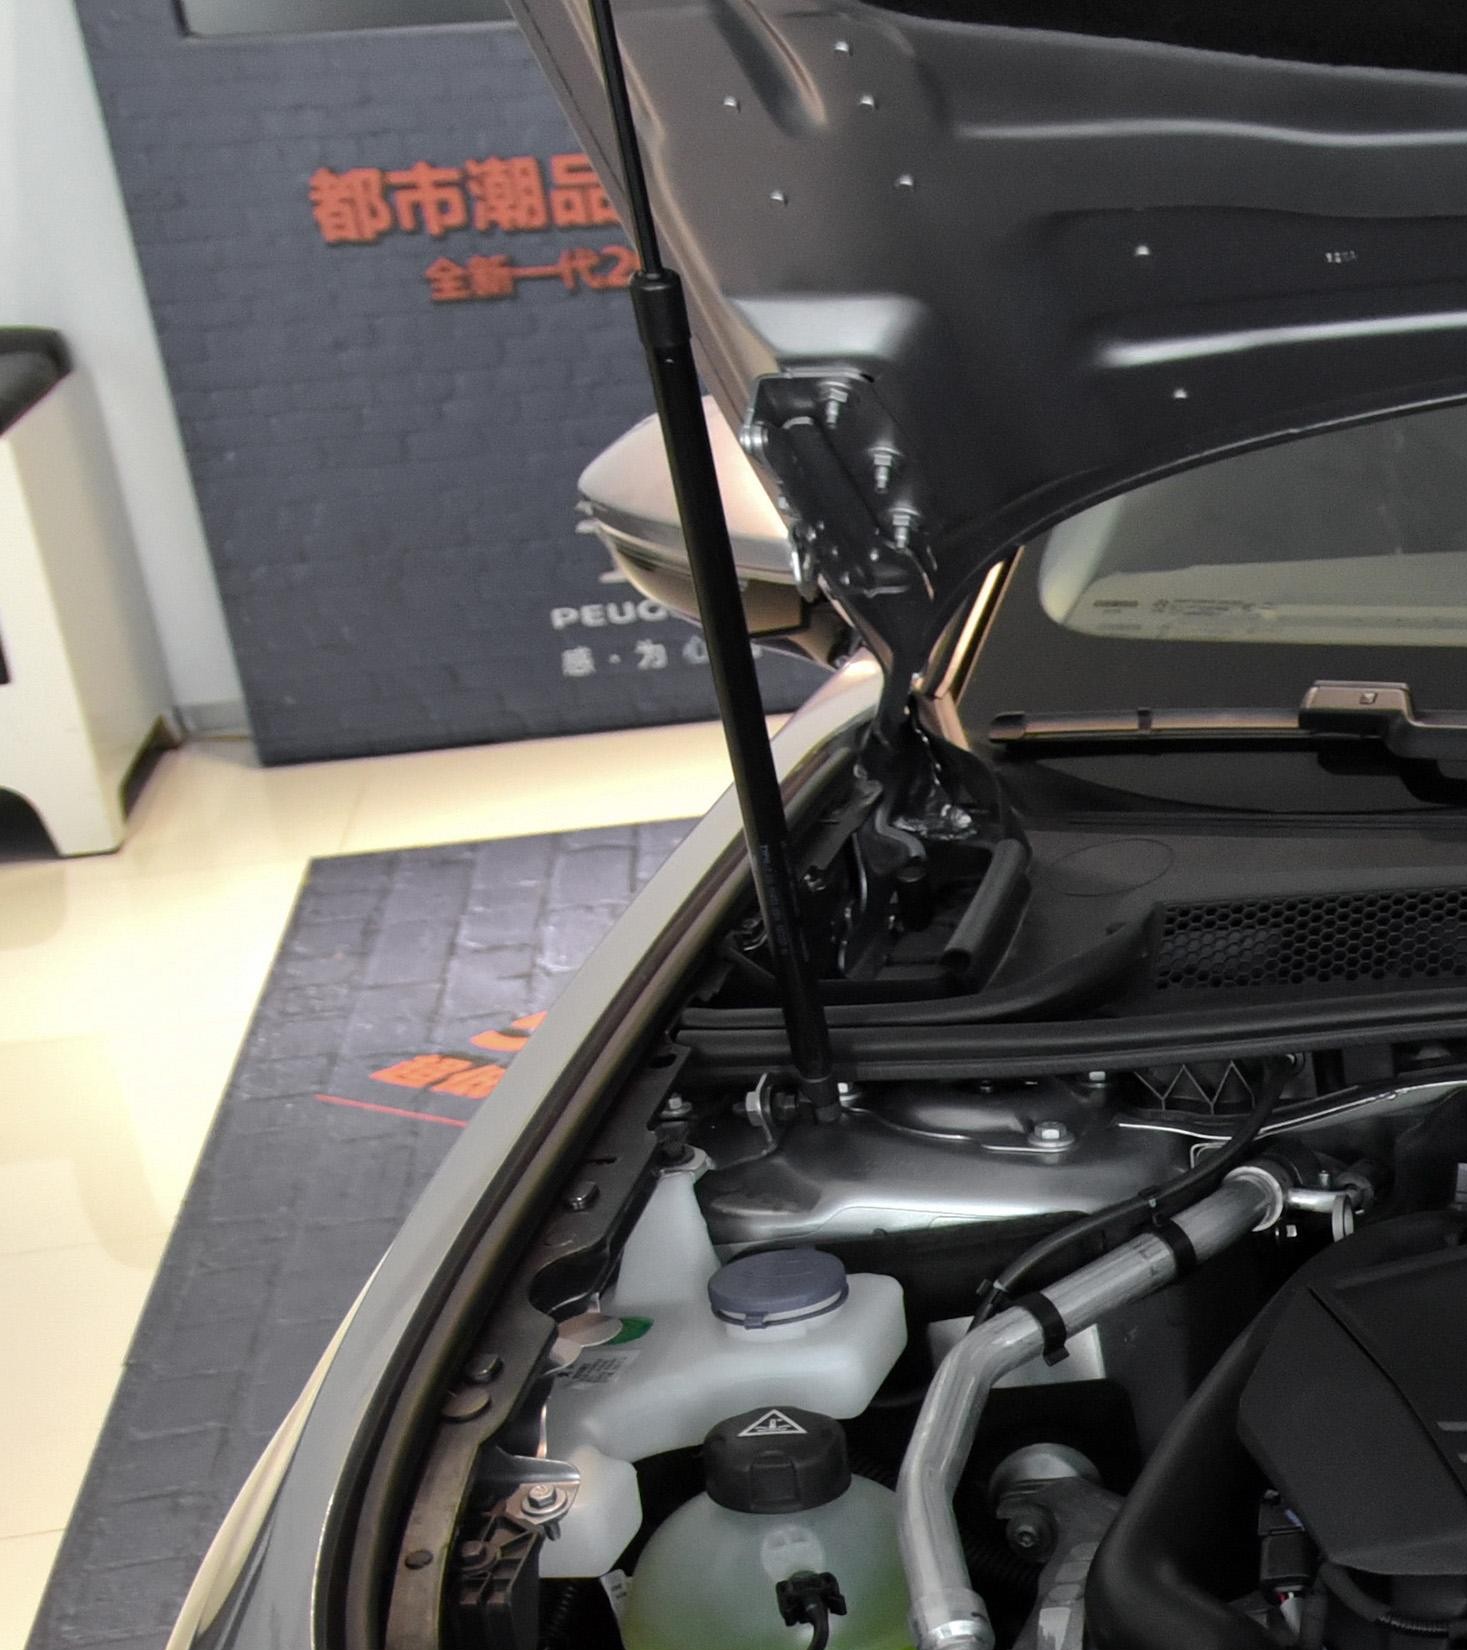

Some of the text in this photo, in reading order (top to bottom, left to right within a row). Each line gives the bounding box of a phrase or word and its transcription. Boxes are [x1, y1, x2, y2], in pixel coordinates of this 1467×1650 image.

[309, 152, 622, 244] 都市潮品
[551, 600, 669, 630] PEUG
